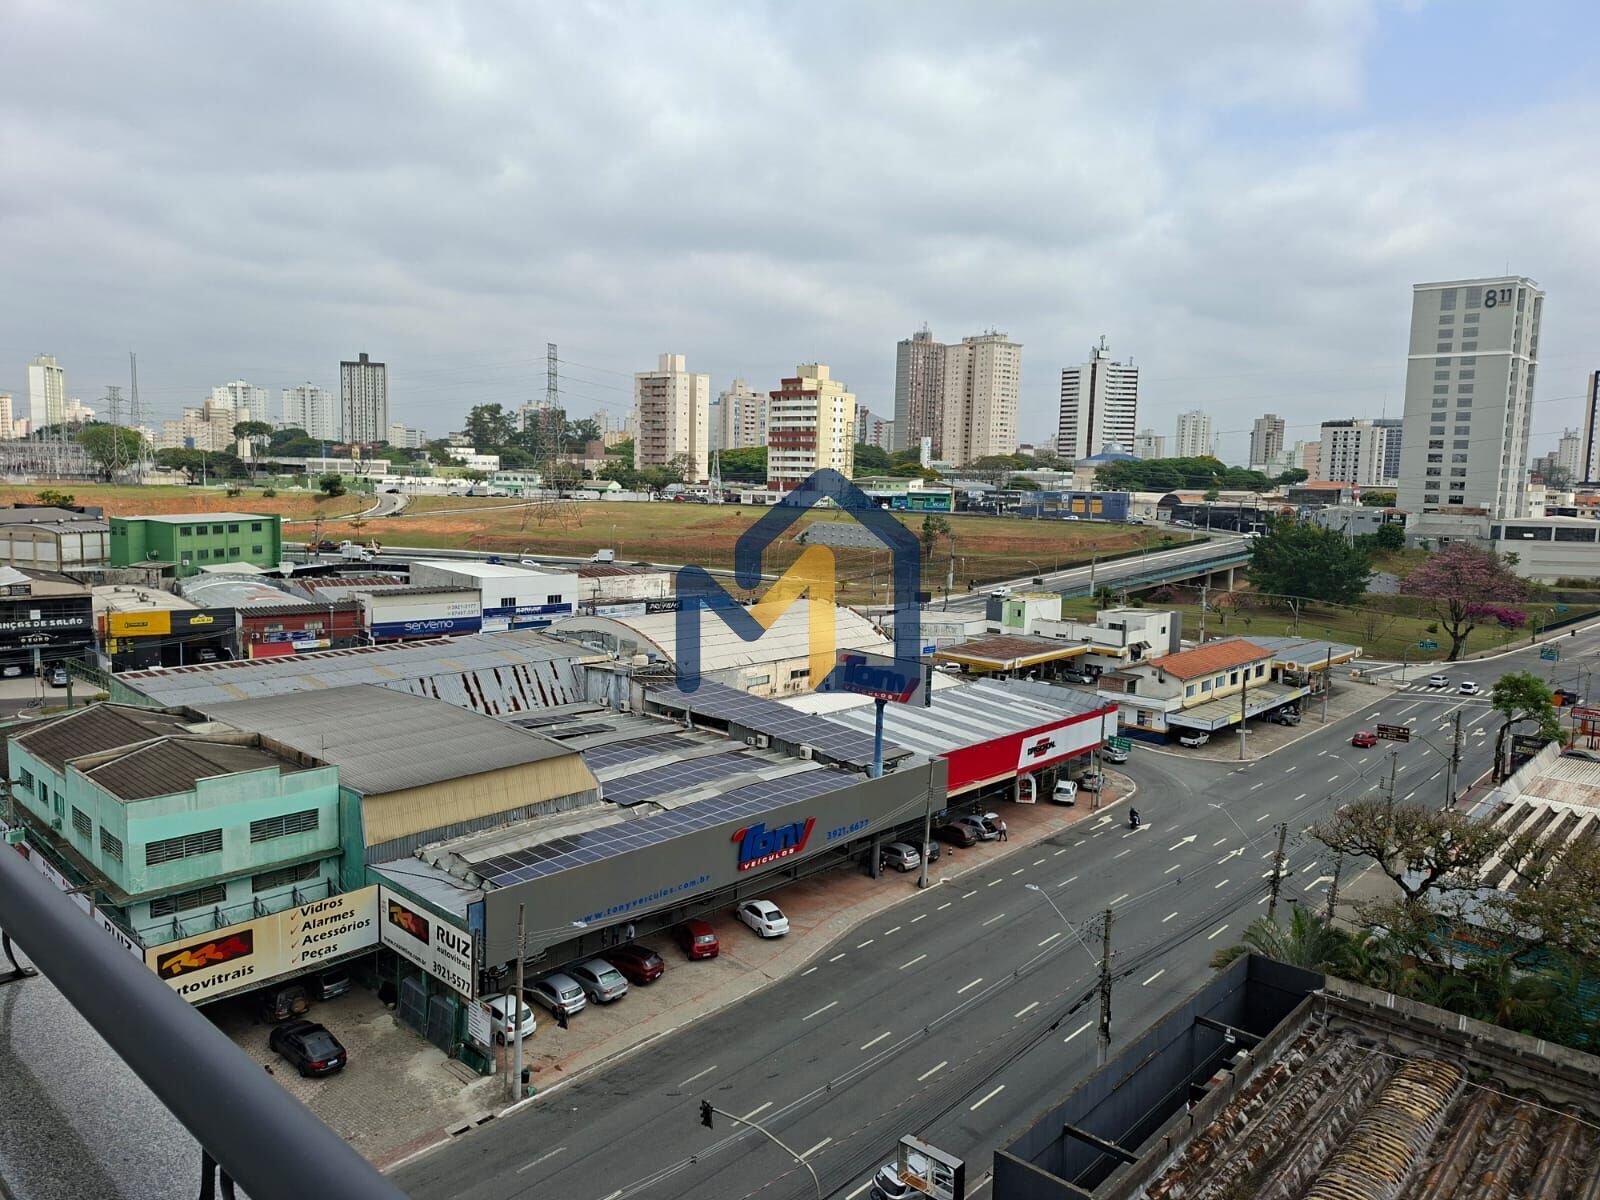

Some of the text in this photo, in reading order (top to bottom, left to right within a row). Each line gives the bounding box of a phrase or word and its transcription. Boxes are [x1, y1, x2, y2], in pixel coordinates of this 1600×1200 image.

[1485, 288, 1512, 308] 811
[404, 620, 454, 631] servemo
[731, 816, 816, 864] Tony
[743, 848, 795, 869] VEICULOS
[301, 898, 343, 917] Vidros
[301, 909, 355, 932] Alarmes
[302, 919, 371, 946] Acessórios
[301, 944, 338, 961] Peças
[436, 925, 471, 959] RUIZ
[436, 945, 471, 970] autovitrais
[177, 965, 254, 995] tovitrais
[432, 961, 471, 993] 3921-5577
